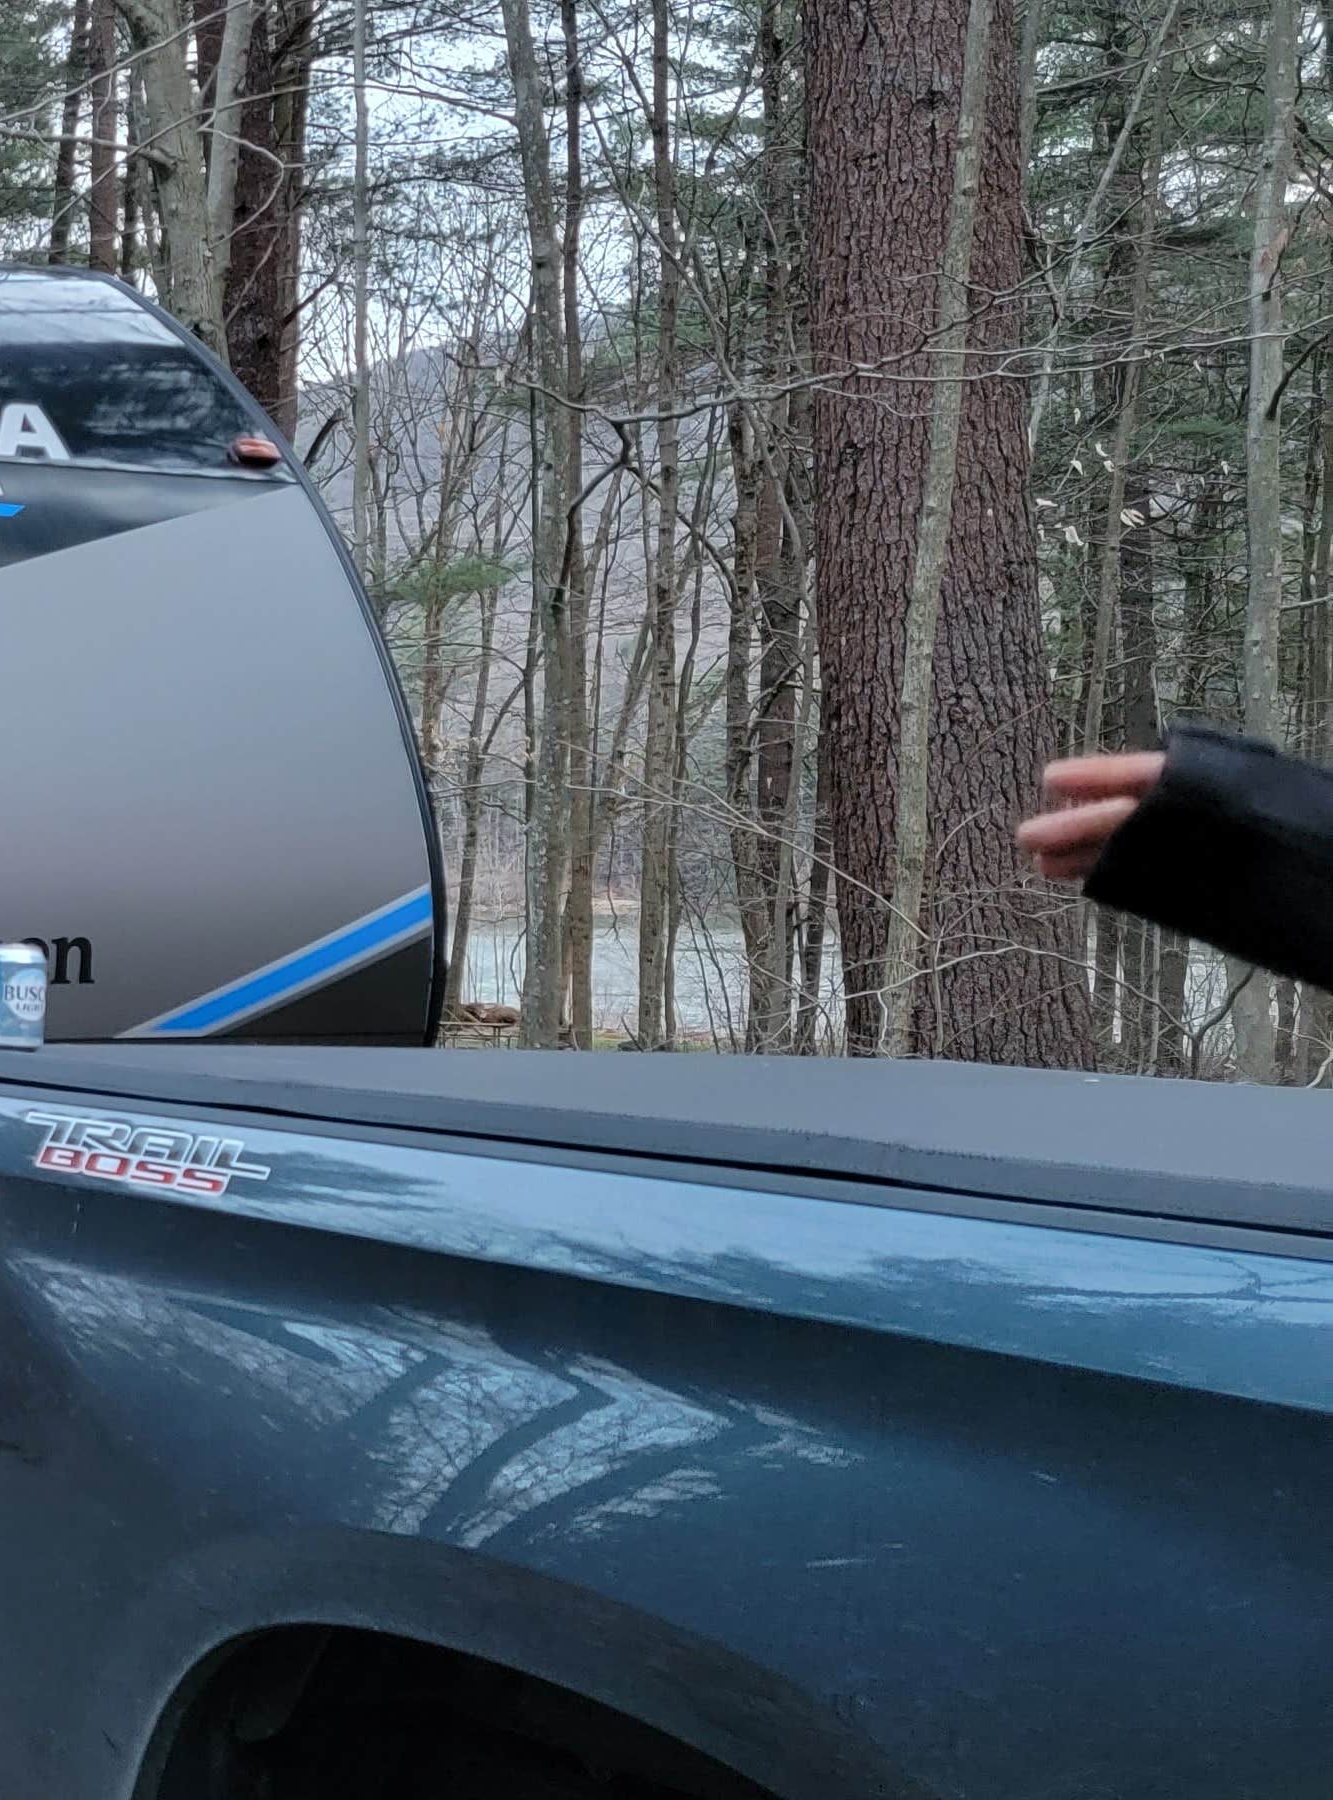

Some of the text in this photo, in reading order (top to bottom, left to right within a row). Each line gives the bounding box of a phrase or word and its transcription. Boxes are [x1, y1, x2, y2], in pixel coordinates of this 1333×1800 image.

[4, 983, 45, 1002] BUSC
[24, 1110, 271, 1182] TRAIL
[34, 1144, 232, 1196] BOSS
